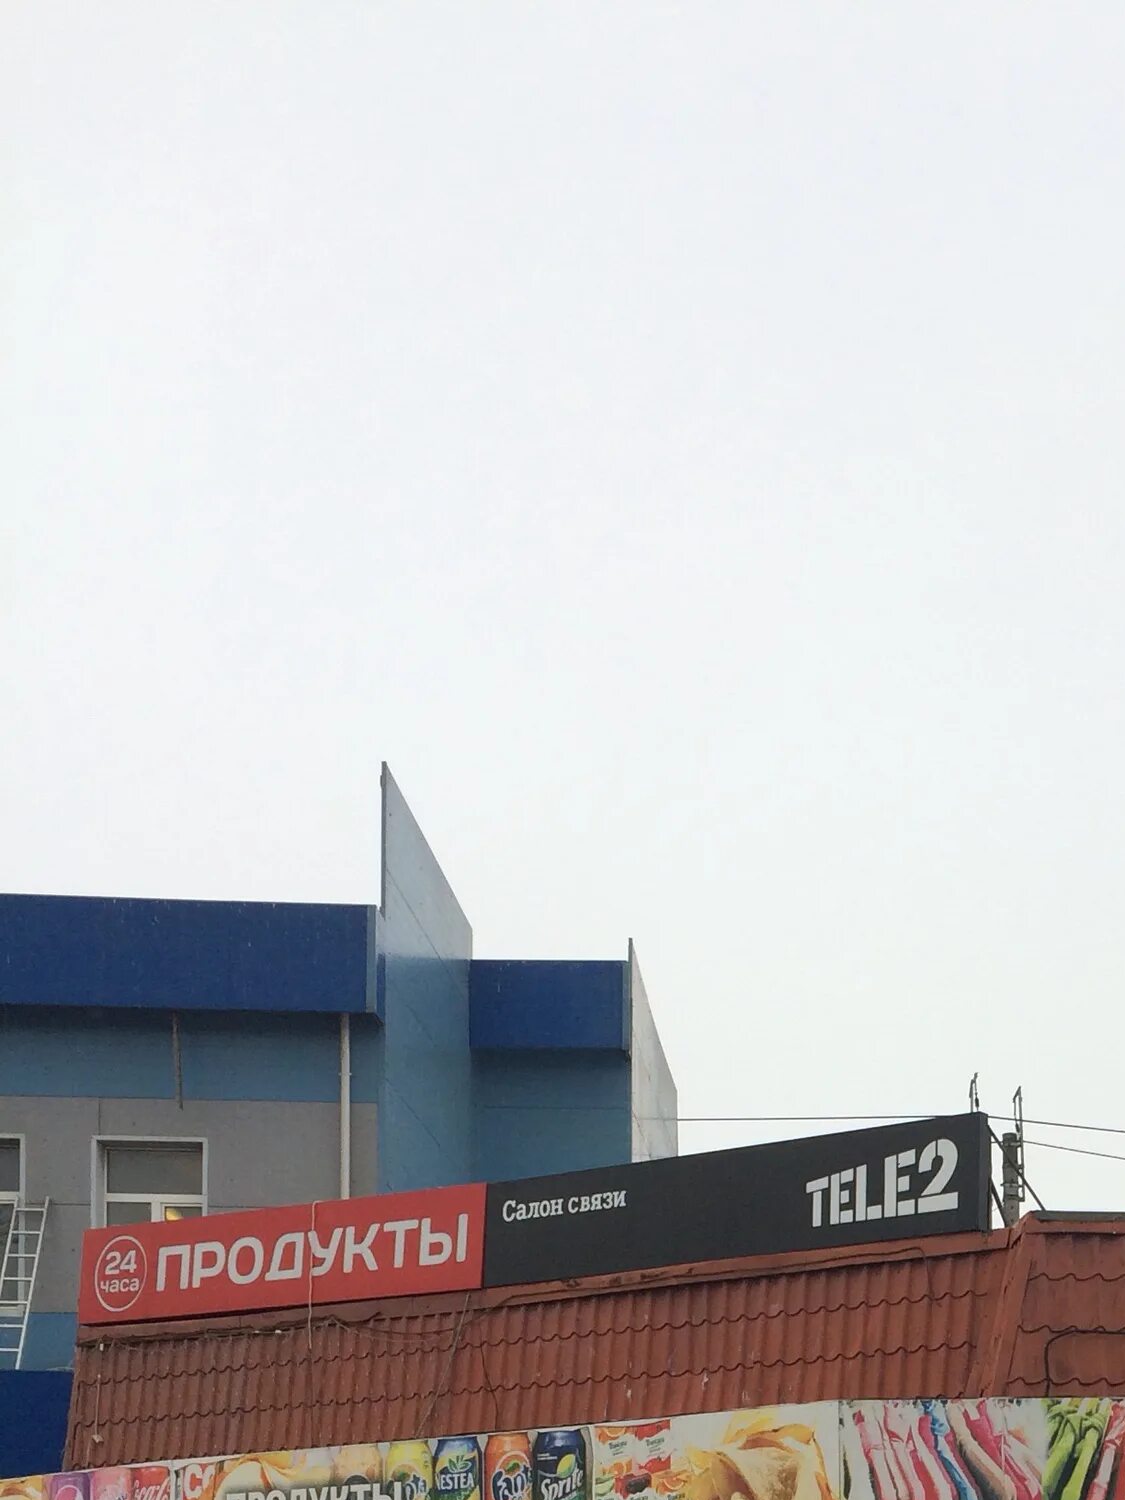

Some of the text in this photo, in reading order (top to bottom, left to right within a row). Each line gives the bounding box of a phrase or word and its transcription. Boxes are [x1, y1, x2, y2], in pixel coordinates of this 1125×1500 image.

[805, 1138, 959, 1228] TELE2
[502, 1190, 627, 1222] Салон связи
[104, 1249, 137, 1275] 24
[156, 1213, 469, 1292] ПРОДУКТЫ
[100, 1276, 140, 1294] часа
